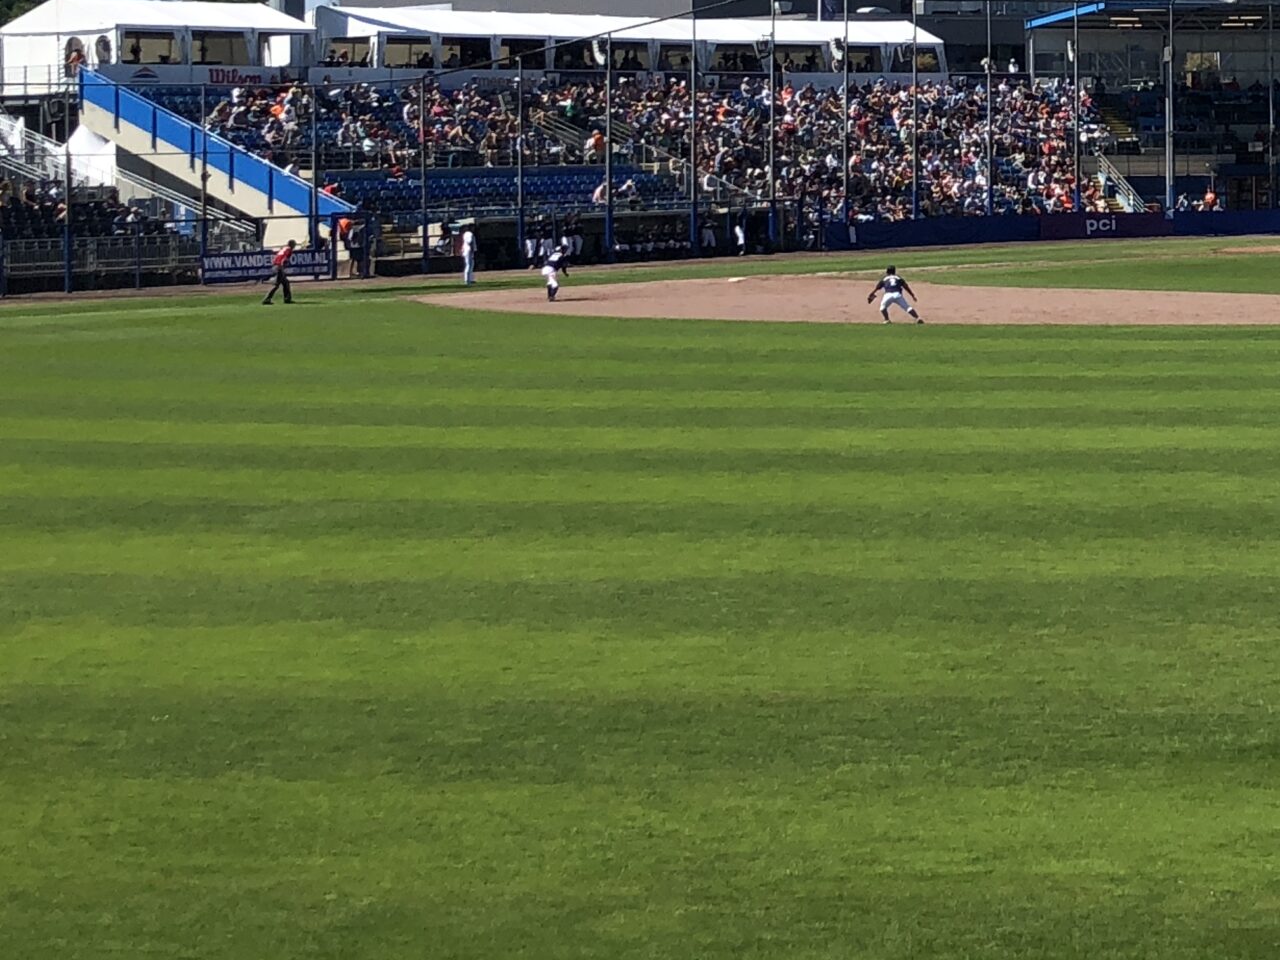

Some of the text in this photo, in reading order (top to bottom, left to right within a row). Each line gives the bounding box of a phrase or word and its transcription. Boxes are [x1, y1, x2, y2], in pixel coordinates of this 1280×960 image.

[209, 69, 262, 84] Wilson
[1086, 215, 1116, 235] pci
[203, 252, 328, 268] WWW.VANDEORM.NL
